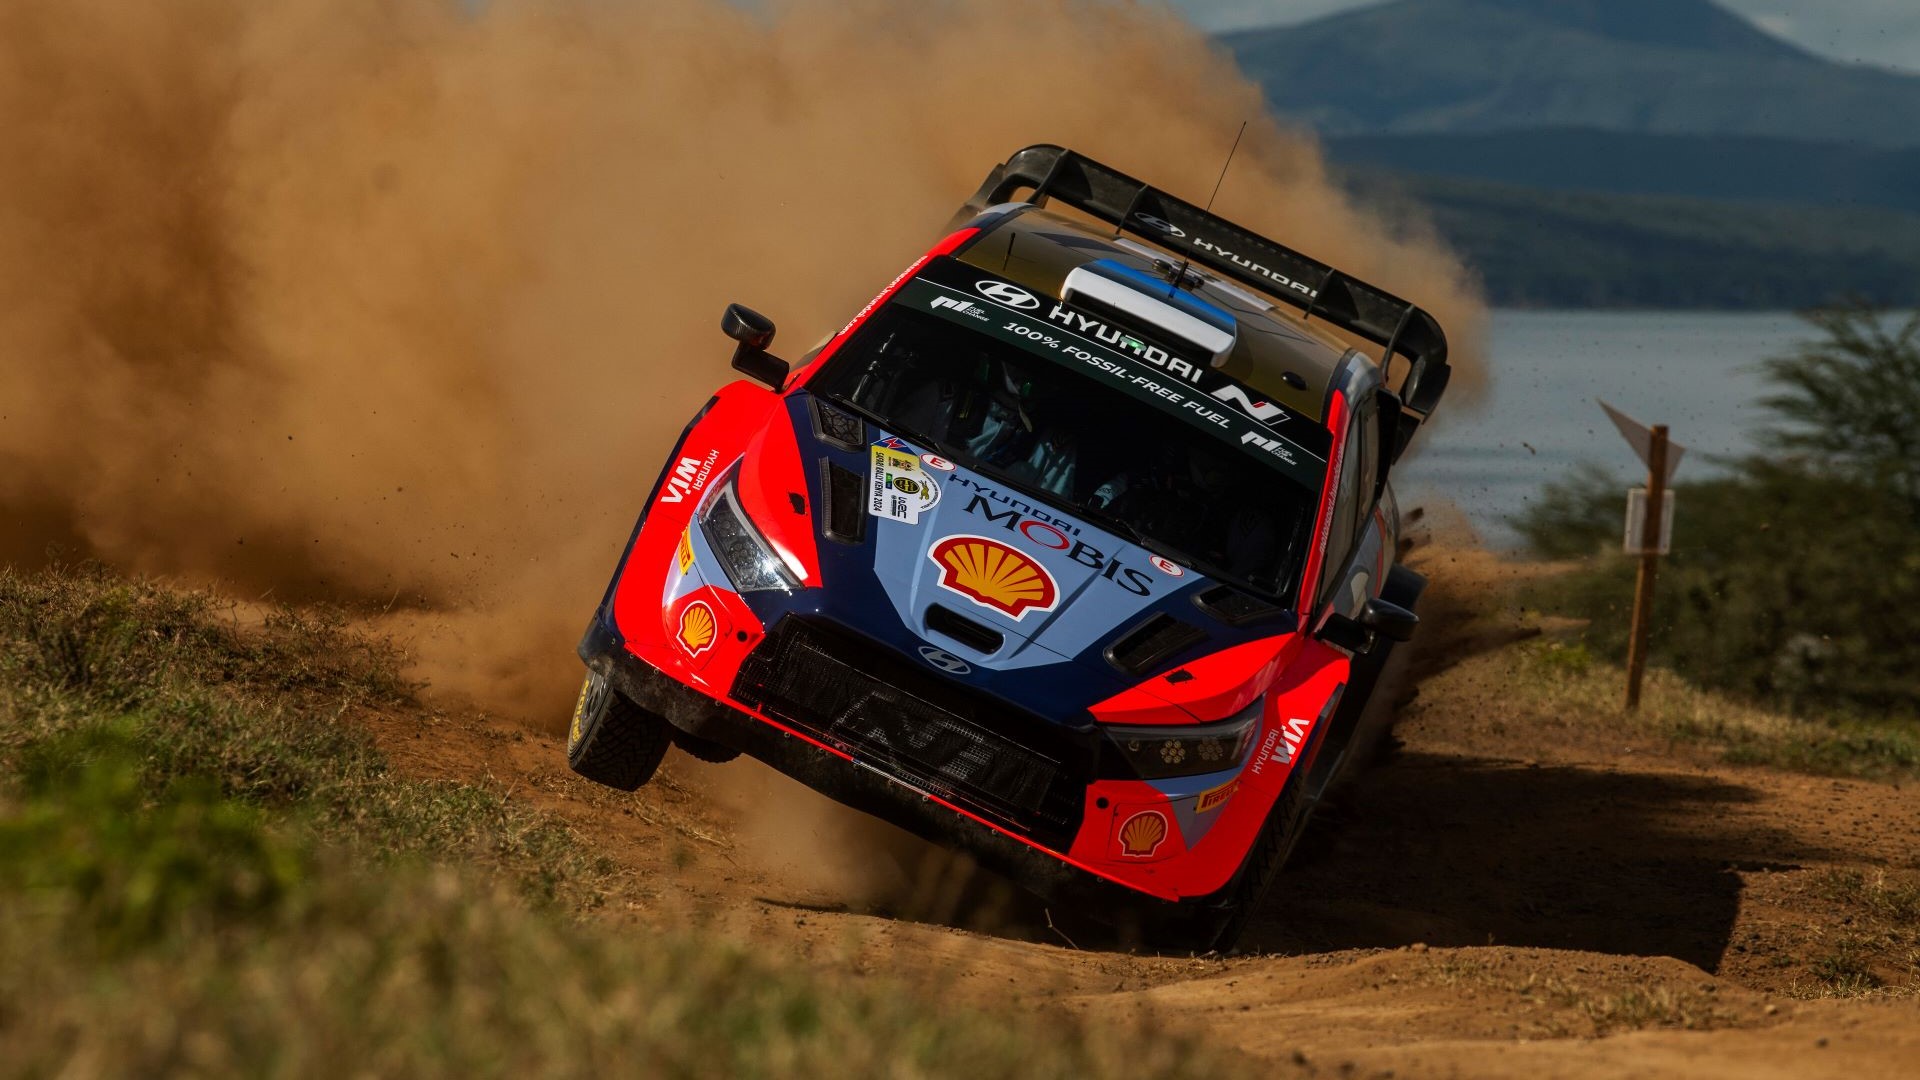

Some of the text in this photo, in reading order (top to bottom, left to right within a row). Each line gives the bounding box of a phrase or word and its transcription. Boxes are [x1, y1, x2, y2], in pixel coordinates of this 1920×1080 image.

[1193, 238, 1318, 298] HYUNDAI
[1002, 322, 1230, 429] 100% FOSSIL-FREE FUEL
[1048, 305, 1203, 383] HYUNDAI
[693, 449, 720, 491] HYUNDAI
[949, 474, 1081, 537] HYUNDAI
[963, 494, 1154, 597] MOBIS
[1252, 729, 1279, 774] HYUNDAI
